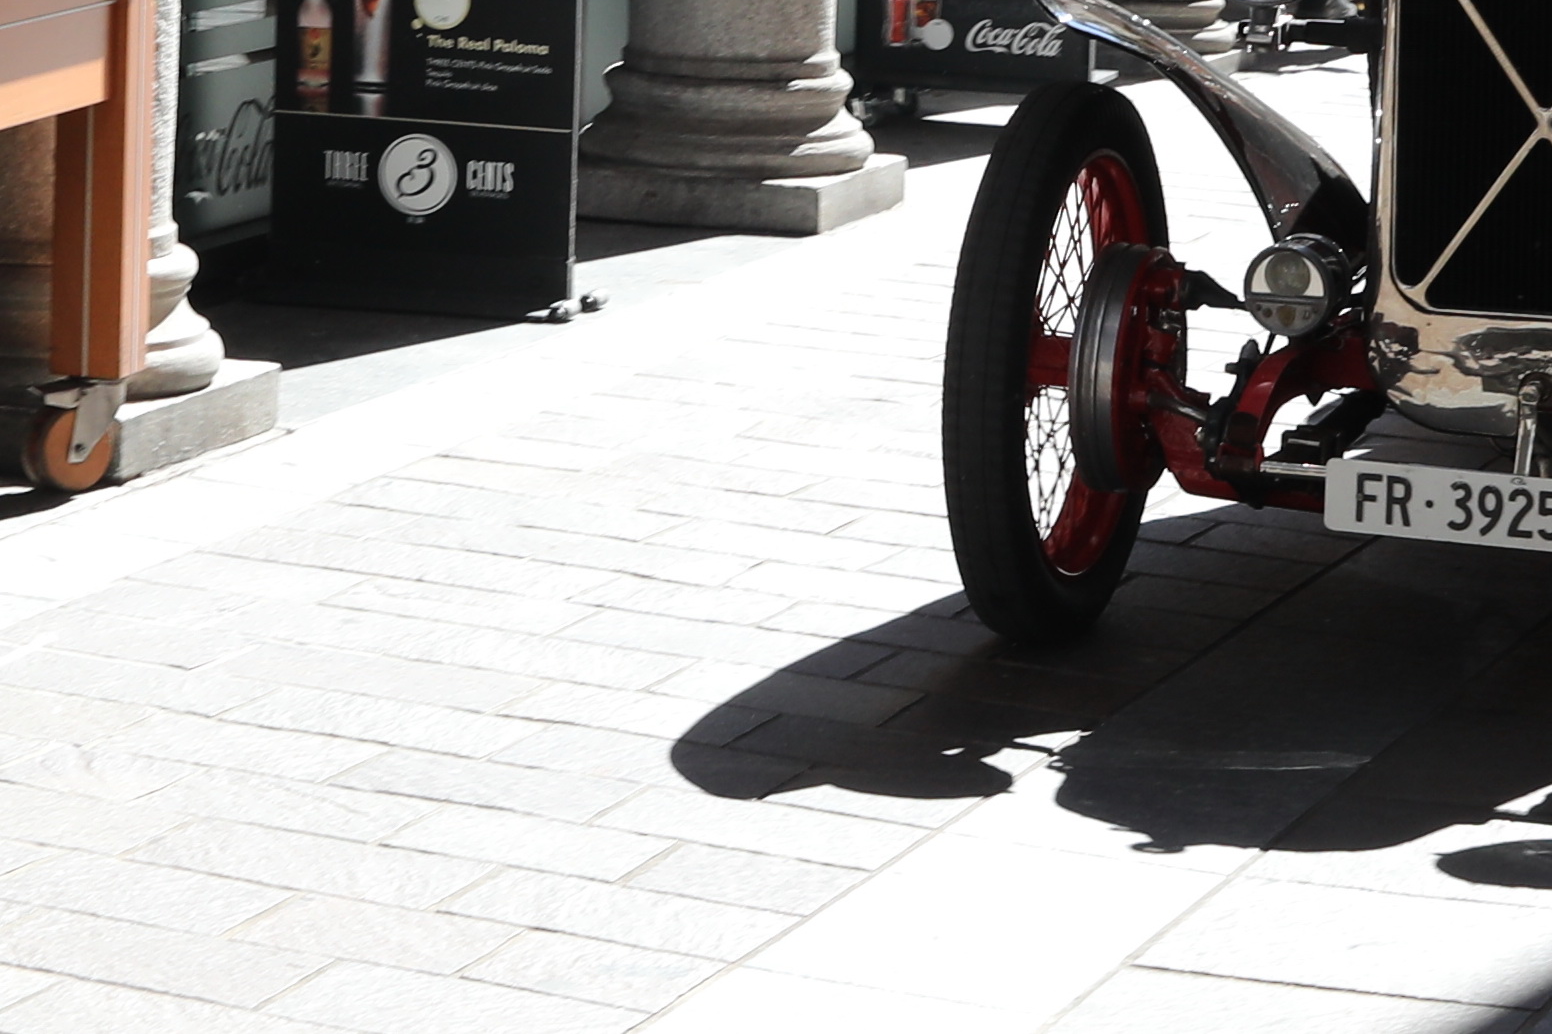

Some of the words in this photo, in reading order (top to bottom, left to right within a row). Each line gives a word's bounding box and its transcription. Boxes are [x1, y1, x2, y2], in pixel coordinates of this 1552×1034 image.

[426, 33, 455, 49] The
[457, 35, 492, 52] Real
[493, 37, 551, 56] Paloma
[964, 18, 1068, 58] Coca-Cola
[323, 149, 370, 181] THREE
[465, 159, 515, 193] CENTS
